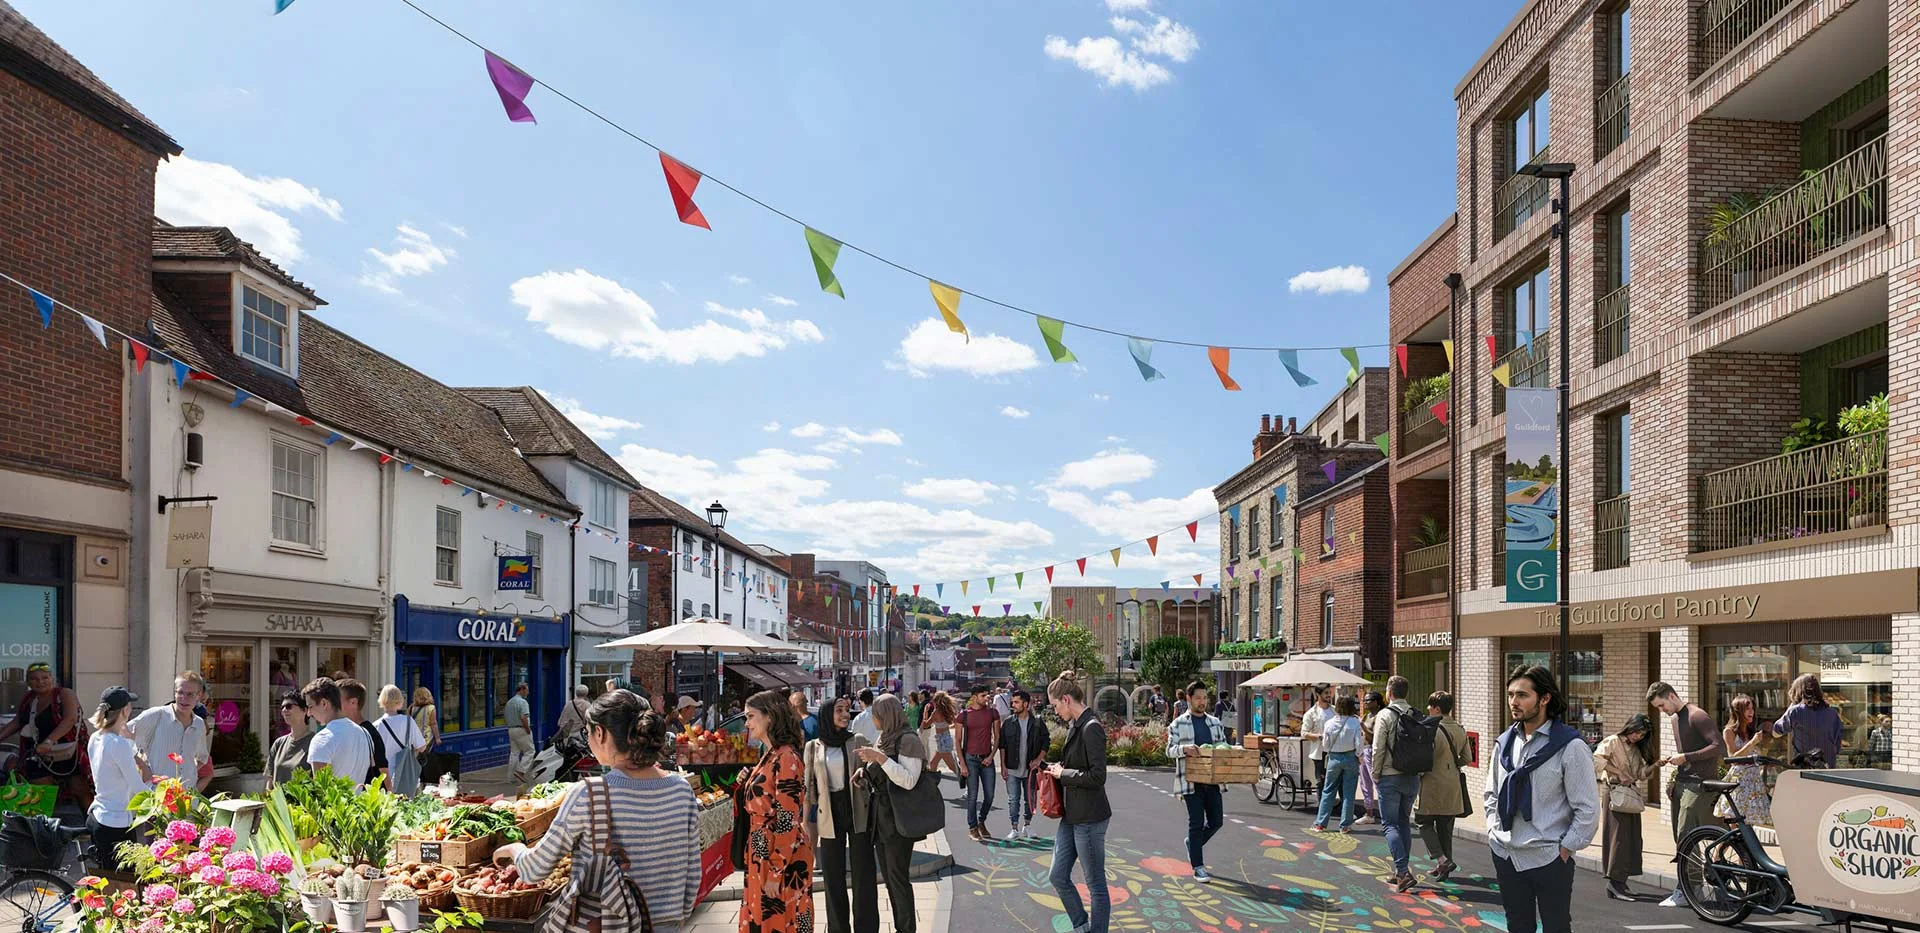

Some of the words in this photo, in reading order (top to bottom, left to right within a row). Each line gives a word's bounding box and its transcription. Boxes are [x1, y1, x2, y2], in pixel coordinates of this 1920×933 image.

[1514, 423, 1551, 431] Guildford
[171, 531, 206, 541] SAHARA
[500, 580, 530, 588] CORAL
[1535, 608, 1562, 628] The
[1571, 598, 1665, 626] Guildford
[1674, 593, 1760, 619] Pantry
[264, 614, 324, 632] SAHARA
[458, 618, 517, 642] CORAL
[1391, 635, 1405, 648] THE
[1406, 631, 1452, 648] HAZELMERE
[0, 643, 50, 656] LORER
[219, 710, 237, 723] Sale
[1829, 826, 1920, 857] ORGANIC
[1847, 852, 1902, 880] SHOP
